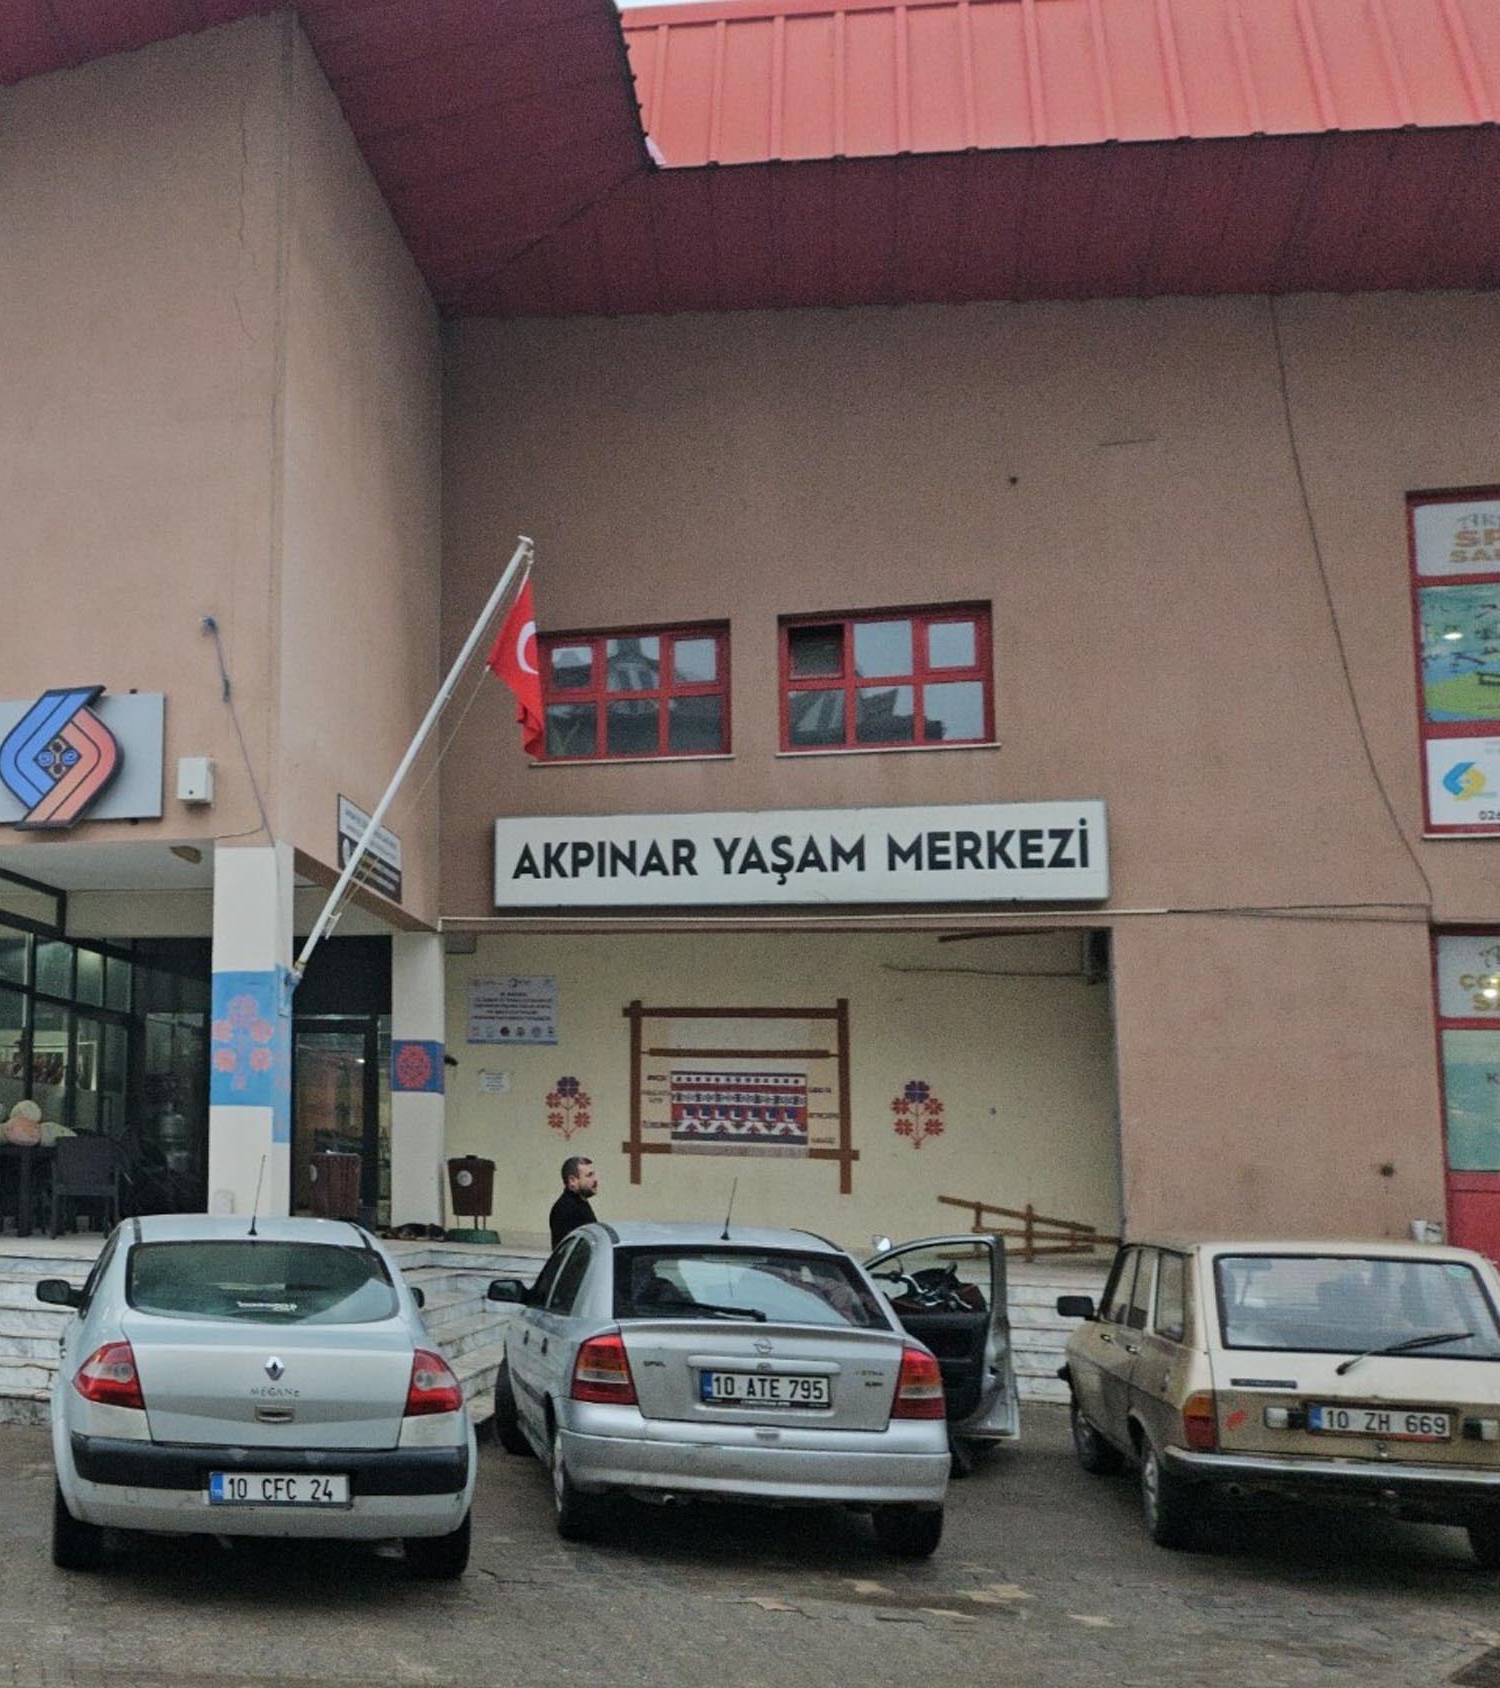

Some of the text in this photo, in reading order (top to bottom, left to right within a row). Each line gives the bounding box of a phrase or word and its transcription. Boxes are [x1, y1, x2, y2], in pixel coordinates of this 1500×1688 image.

[1449, 548, 1500, 564] SA
[512, 817, 1090, 886] AKPINAR YAŞAM MERKEZİ
[713, 1376, 824, 1400] 10 ATE 795
[1326, 1410, 1446, 1435] 10 ZH 669
[228, 1478, 333, 1501] 10 CFC 24
